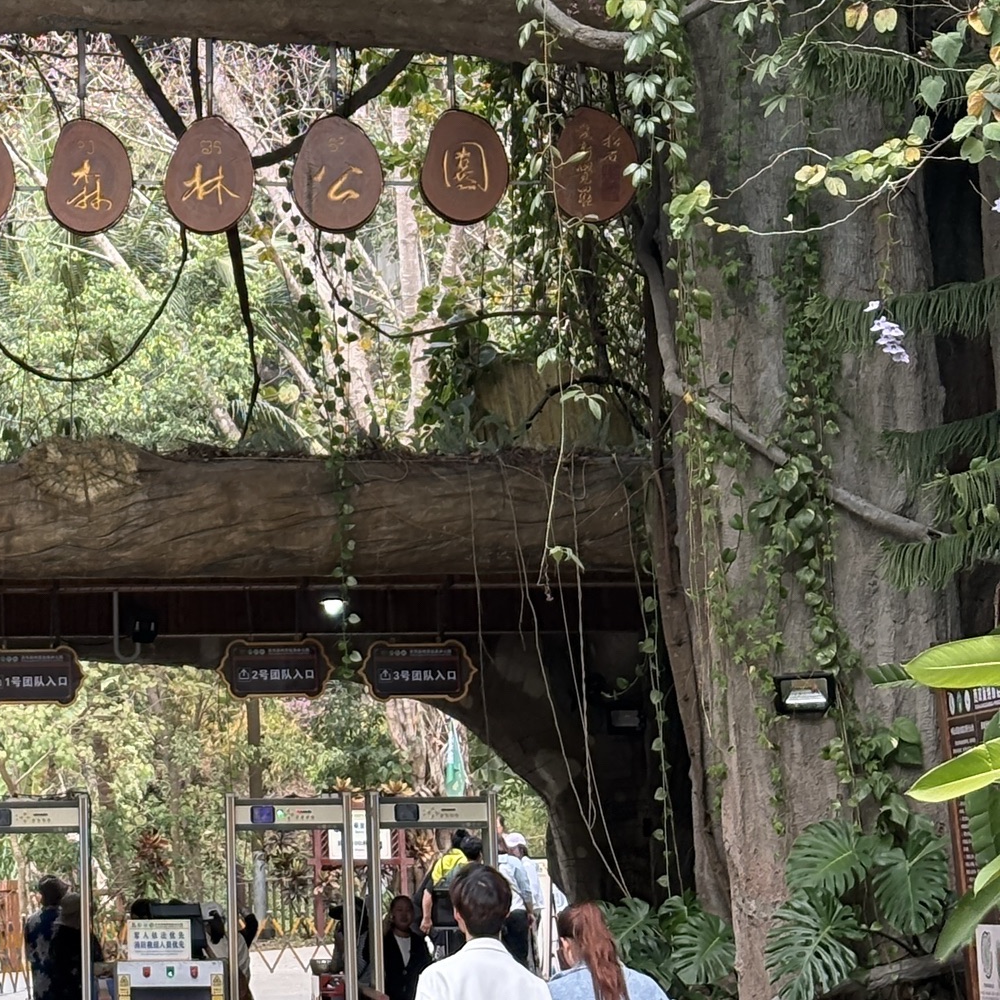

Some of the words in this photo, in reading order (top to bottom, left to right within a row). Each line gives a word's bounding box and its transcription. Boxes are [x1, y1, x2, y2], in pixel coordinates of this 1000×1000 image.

[251, 669, 316, 681] 2号团队入口
[392, 670, 457, 682] 3号团队入口
[4, 675, 68, 688] 1号团队入口
